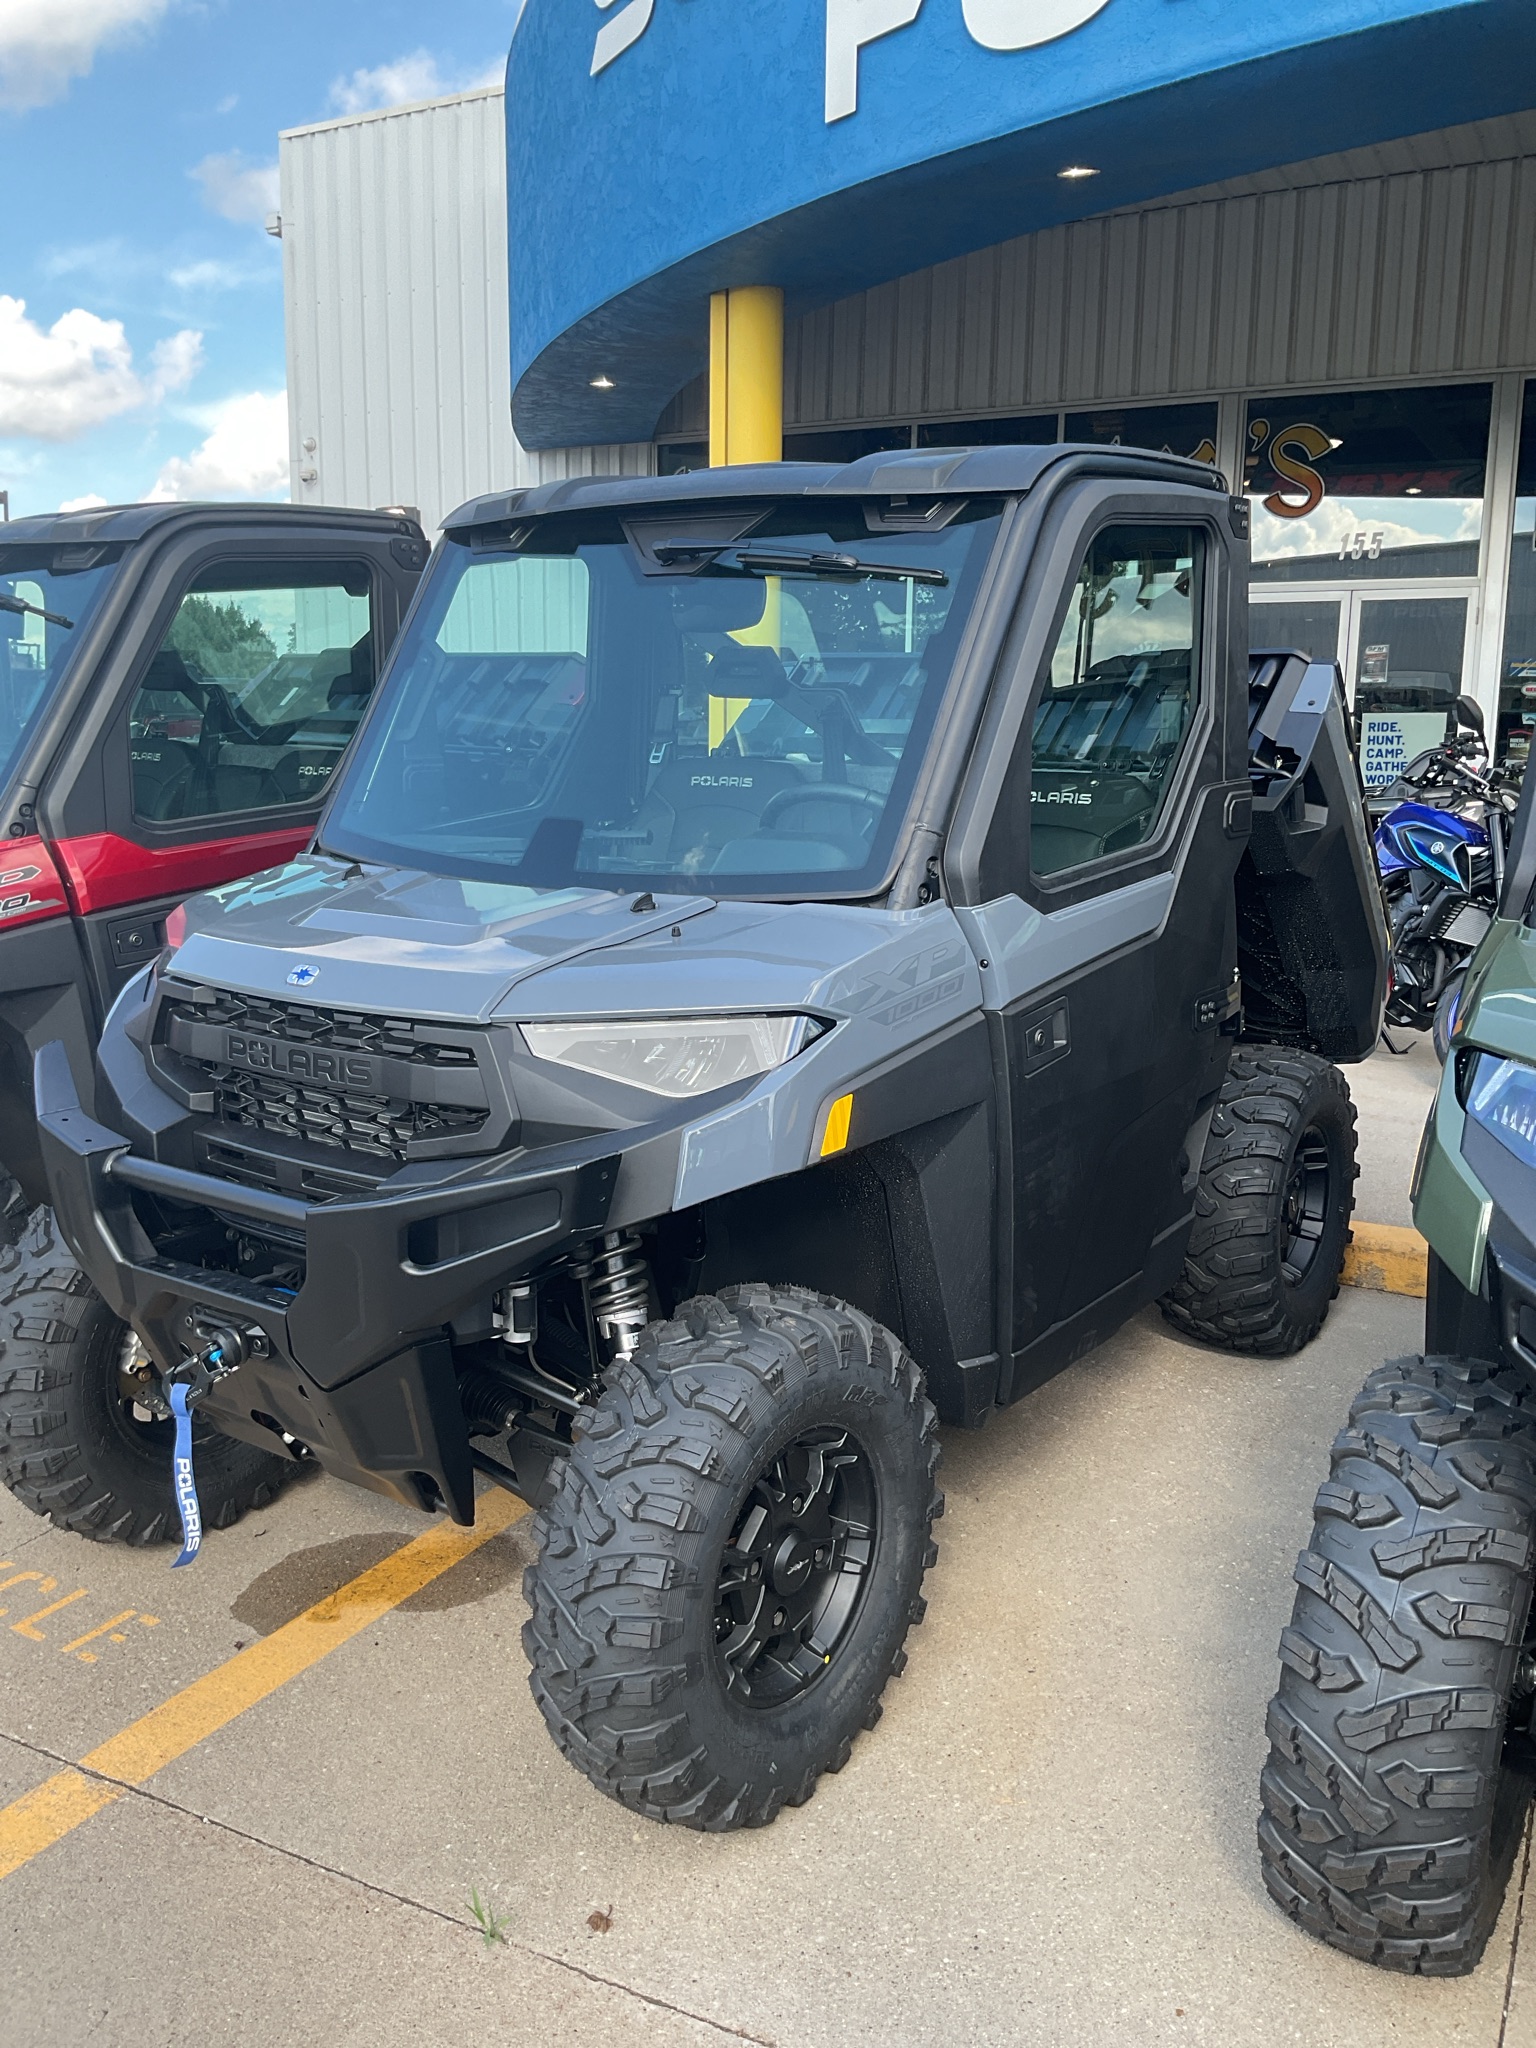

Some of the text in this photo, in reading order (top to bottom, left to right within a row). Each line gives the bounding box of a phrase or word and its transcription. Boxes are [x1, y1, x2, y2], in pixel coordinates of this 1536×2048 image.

[1338, 531, 1385, 561] 155
[1368, 721, 1402, 732] RIDE.
[1367, 735, 1406, 746] HUNT.
[130, 751, 162, 762] OLARIS
[1366, 748, 1407, 759] CAMP.
[298, 766, 333, 776] POLAR
[1365, 761, 1409, 772] GATHE
[691, 775, 753, 788] POLARIS
[1365, 774, 1398, 785] WOR
[1030, 791, 1092, 805] OLARIS
[858, 937, 966, 1015] XP
[878, 972, 965, 1026] 1000
[227, 1034, 373, 1087] POLARIS
[176, 1457, 200, 1552] POLARIS
